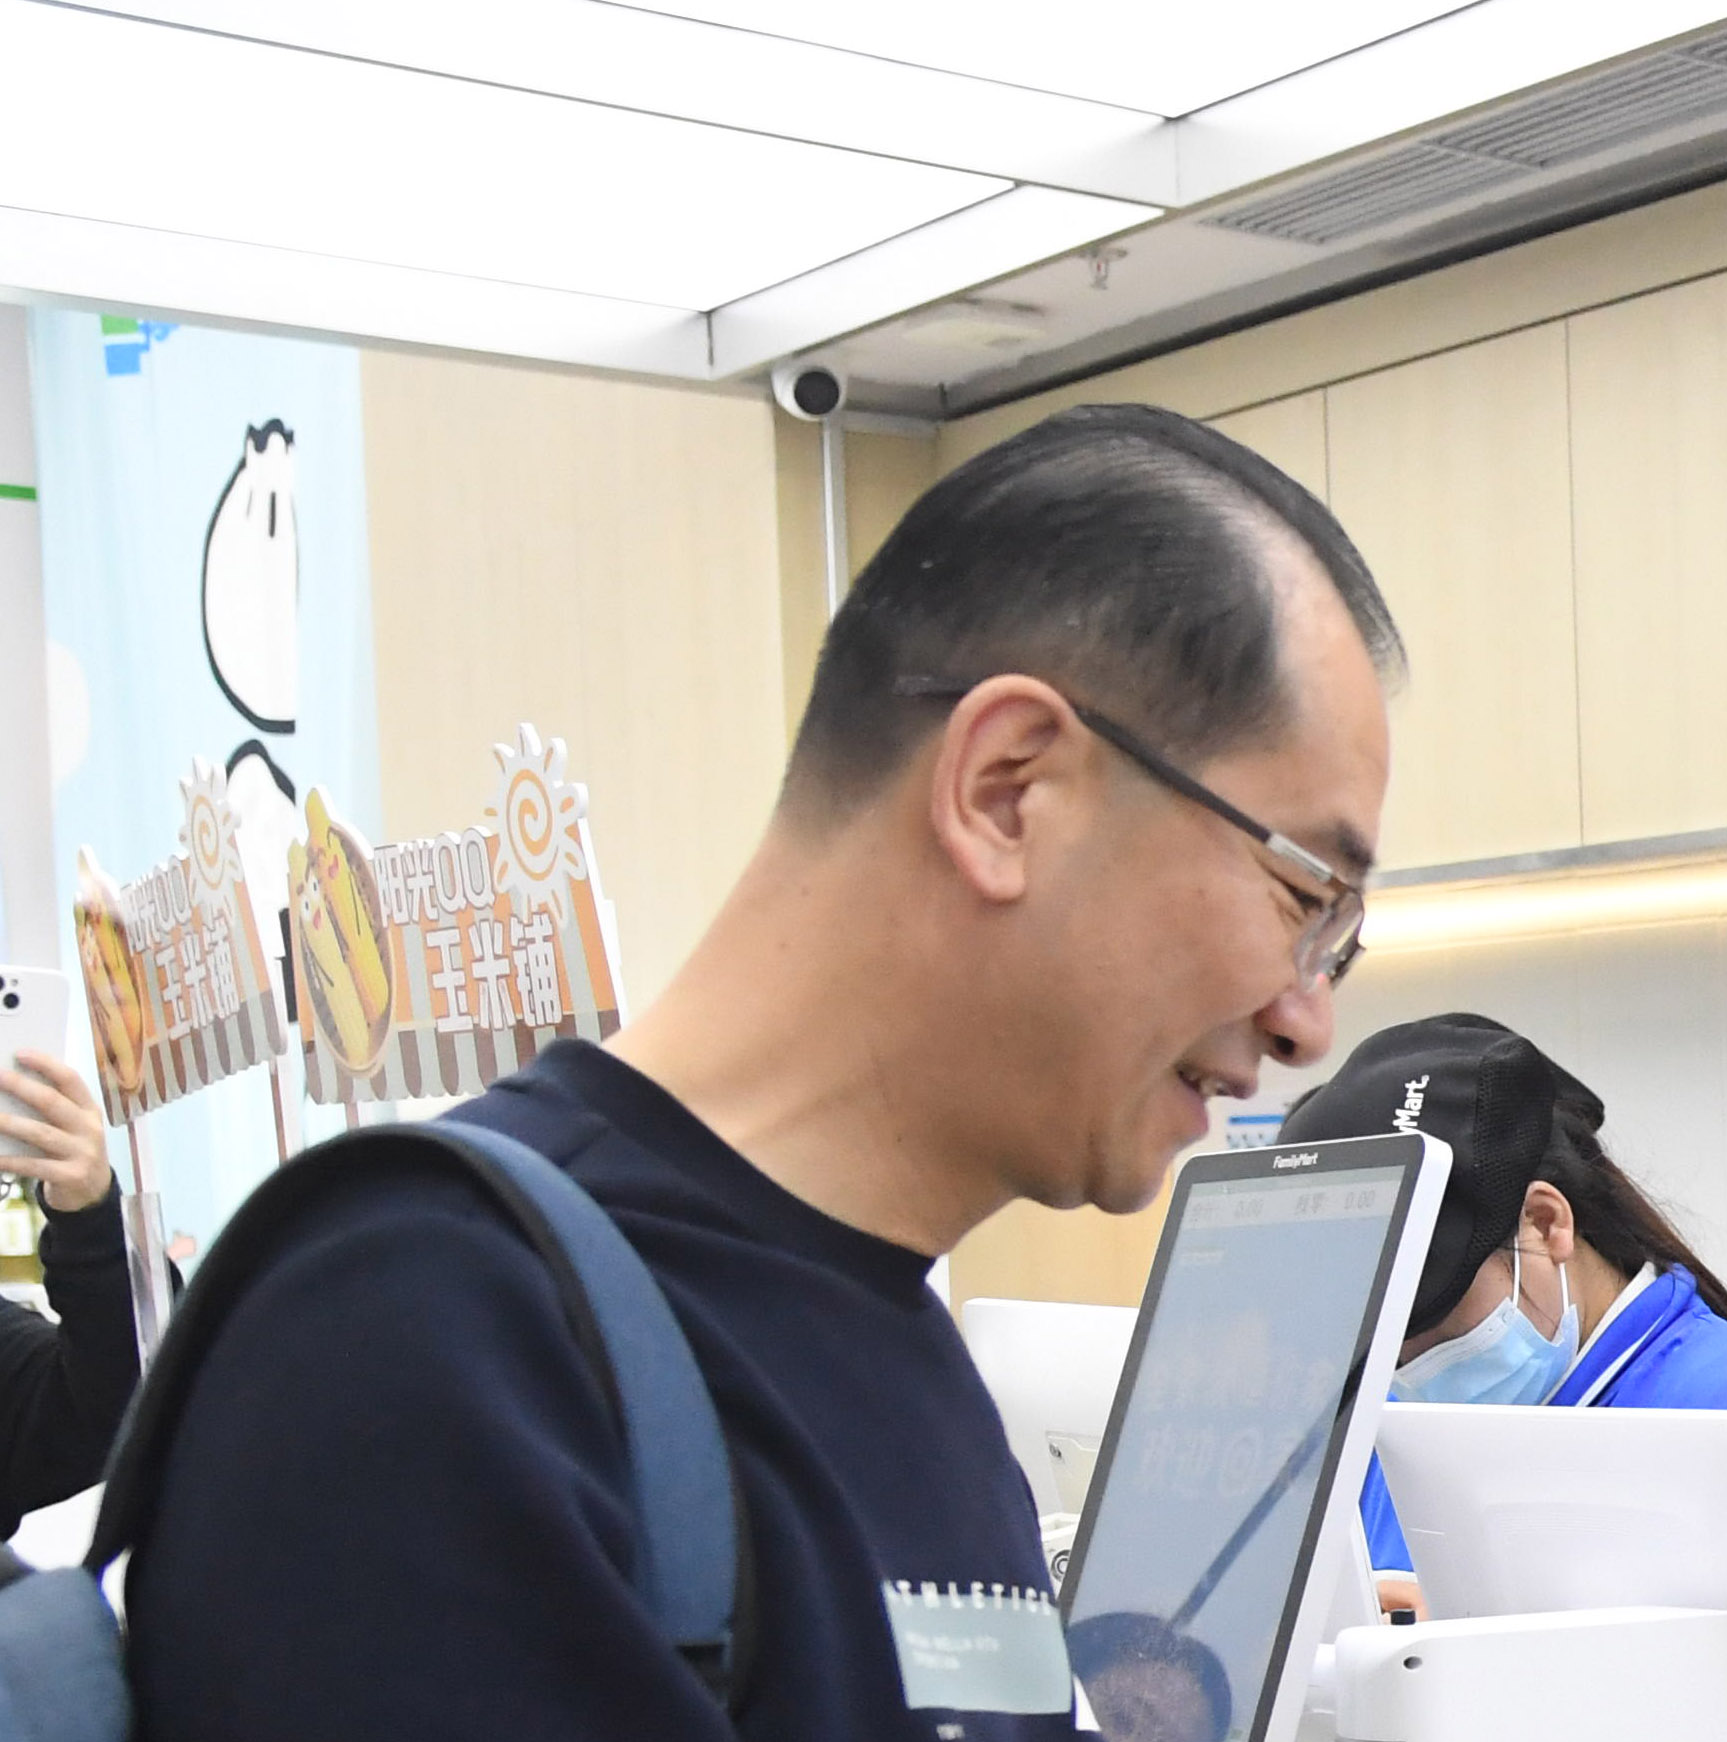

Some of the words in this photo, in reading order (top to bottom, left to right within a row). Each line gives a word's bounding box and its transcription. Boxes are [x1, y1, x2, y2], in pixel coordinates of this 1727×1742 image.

[374, 828, 496, 928] 阳光QQ
[155, 916, 240, 1041] 玉米铺
[426, 912, 563, 1033] 玉米铺
[1273, 1153, 1319, 1170] FamilyMart
